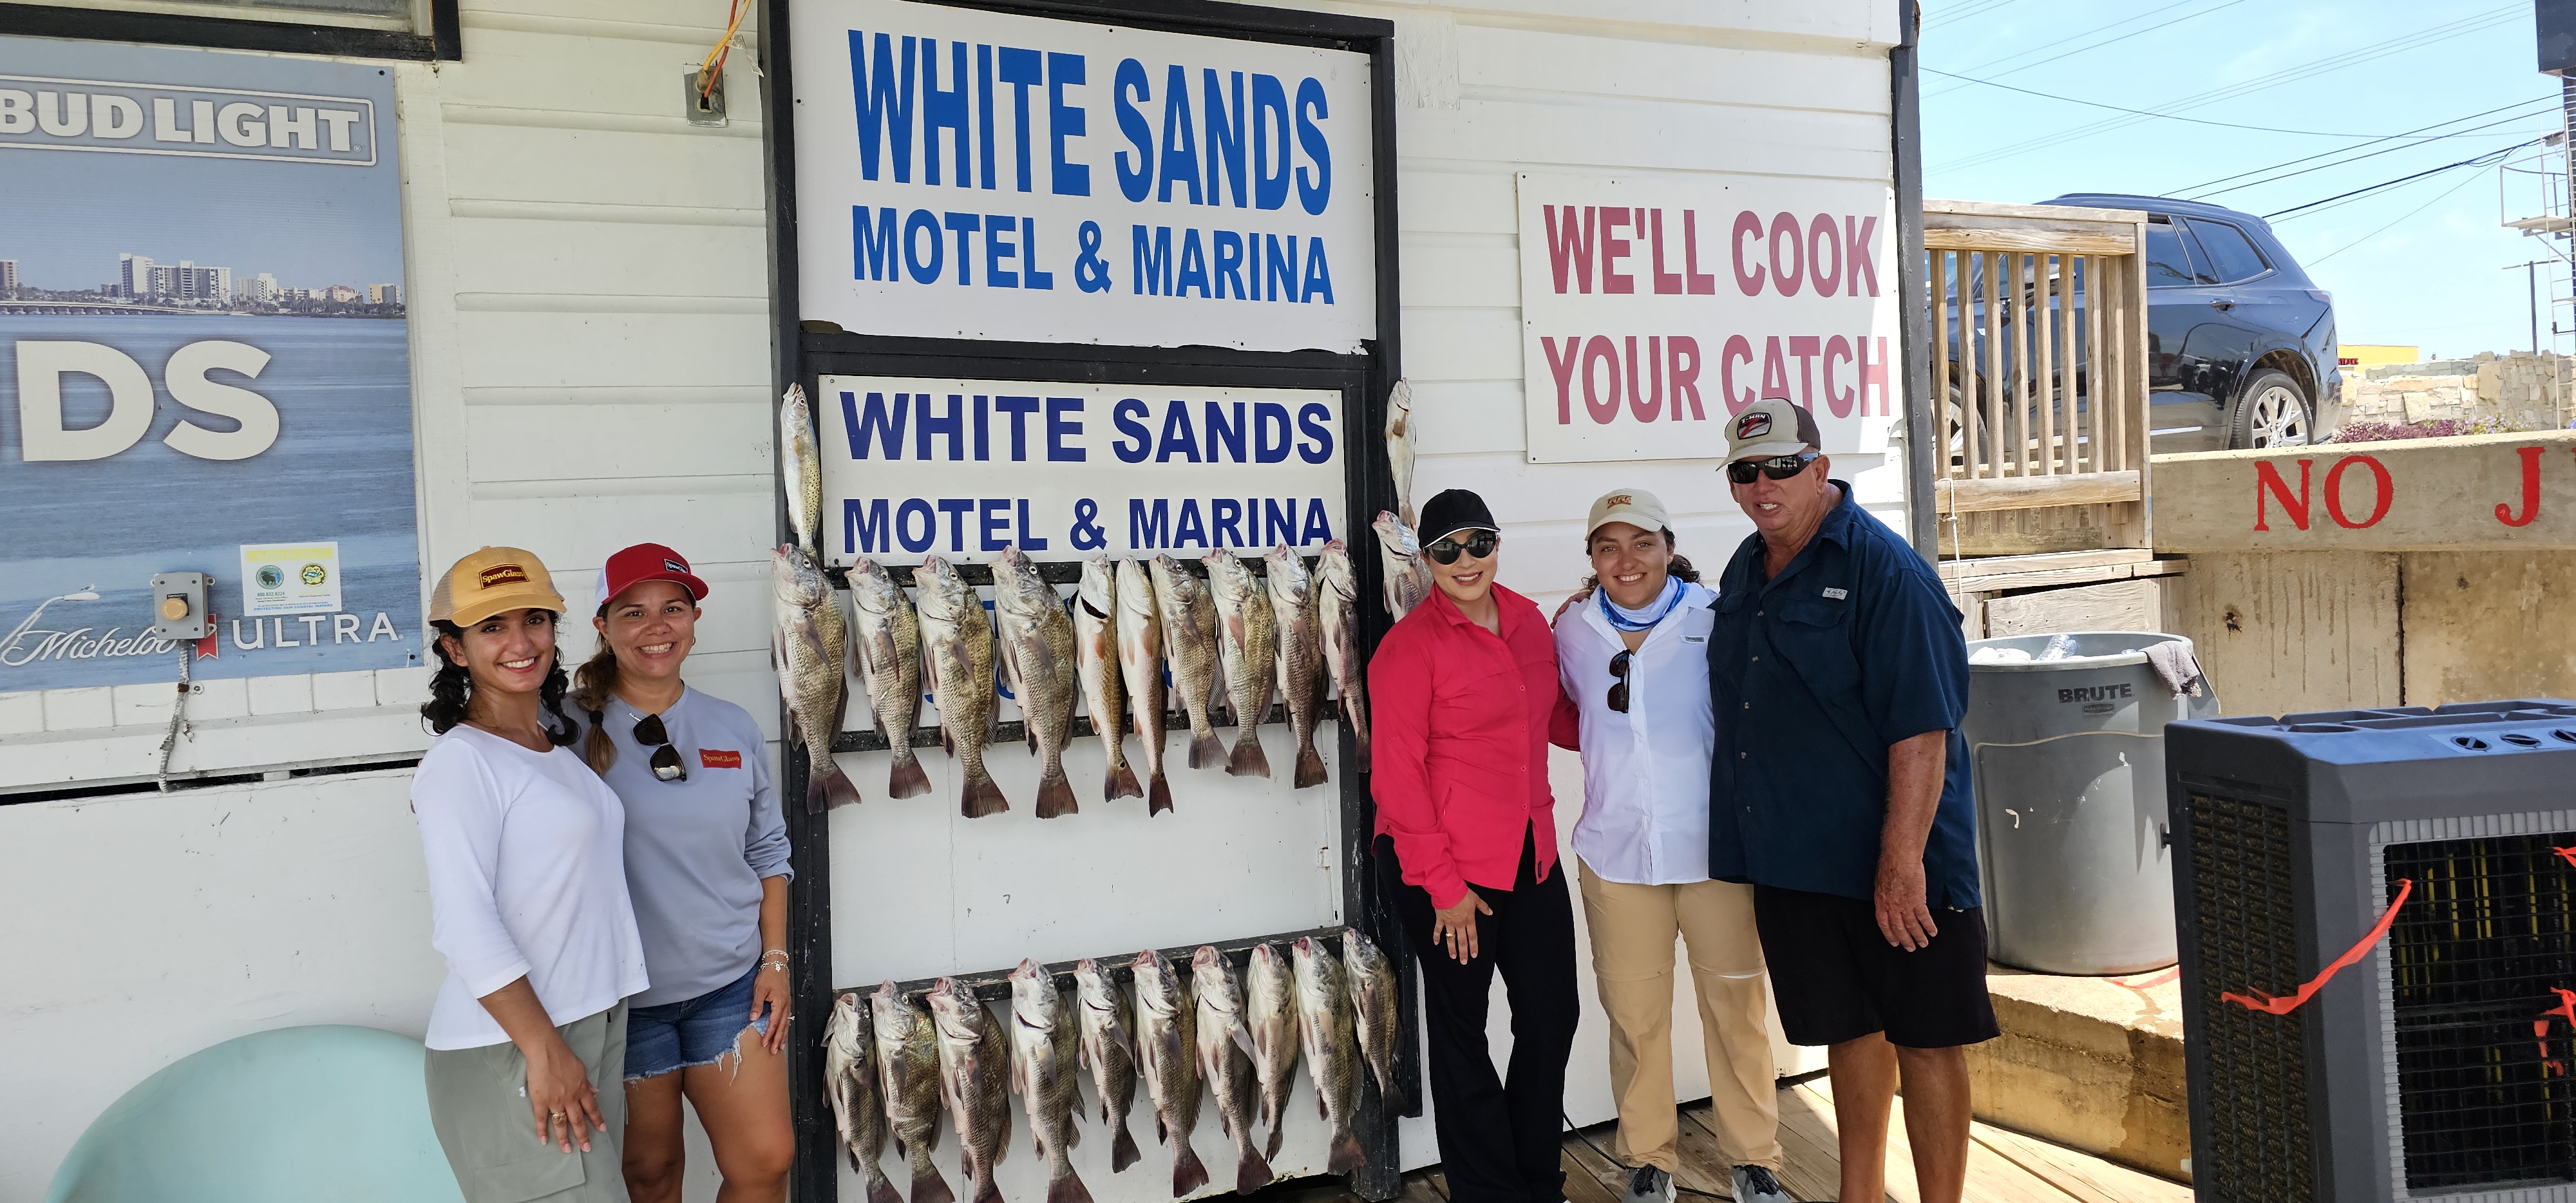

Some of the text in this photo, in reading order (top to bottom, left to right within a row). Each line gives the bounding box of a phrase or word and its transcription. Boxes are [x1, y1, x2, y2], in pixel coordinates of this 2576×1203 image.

[0, 90, 359, 151] BUD LIGHT
[848, 30, 1331, 215] WHITE SANDS
[853, 205, 1334, 304] MOTEL & MARINA
[1544, 205, 1880, 297] WE'LL COOK
[16, 341, 279, 461] DS
[1541, 334, 1889, 424] YOUR CATCH
[840, 392, 1333, 464] WHITE SANDS
[844, 498, 1332, 553] MOTEL & MARINA
[2254, 455, 2393, 531] NO
[482, 569, 524, 583] SpawGlass
[233, 612, 398, 650] ULTRA
[2058, 683, 2132, 703] BRUTE
[703, 754, 740, 763] SpawGlass
